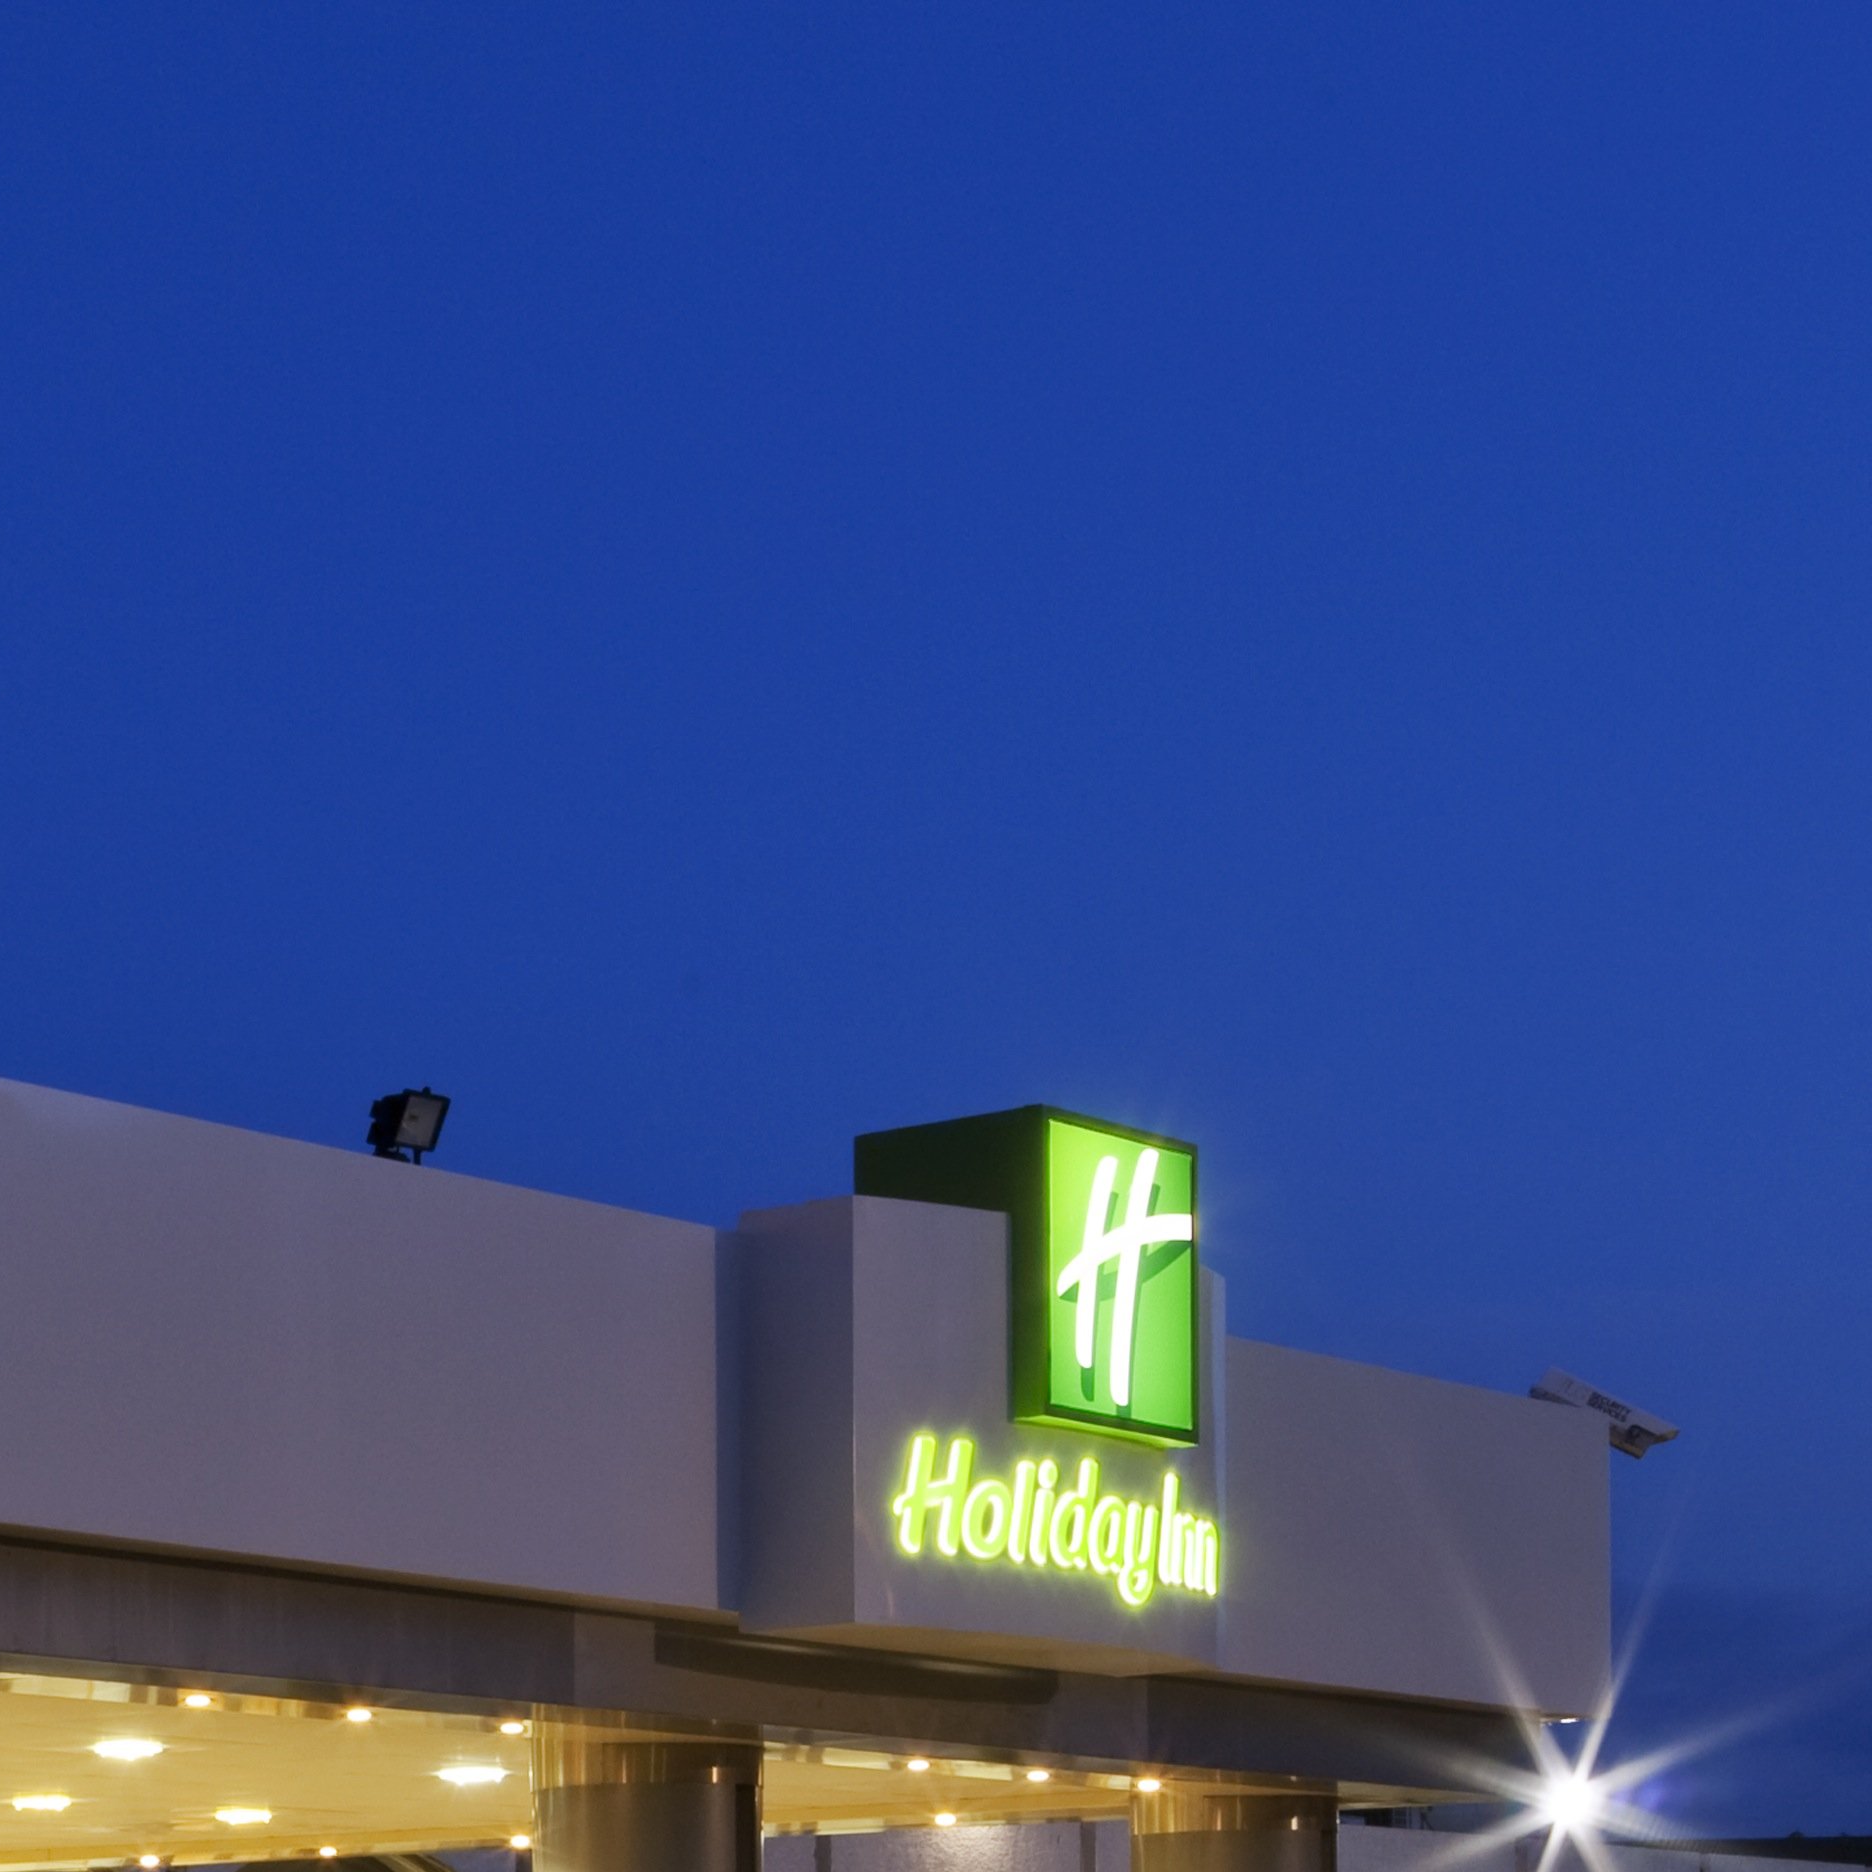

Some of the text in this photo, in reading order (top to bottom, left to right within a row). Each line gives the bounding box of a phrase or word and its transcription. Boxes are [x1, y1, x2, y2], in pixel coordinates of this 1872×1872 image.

[1056, 1148, 1193, 1407] H
[892, 1432, 1221, 1608] Holiday Inn
